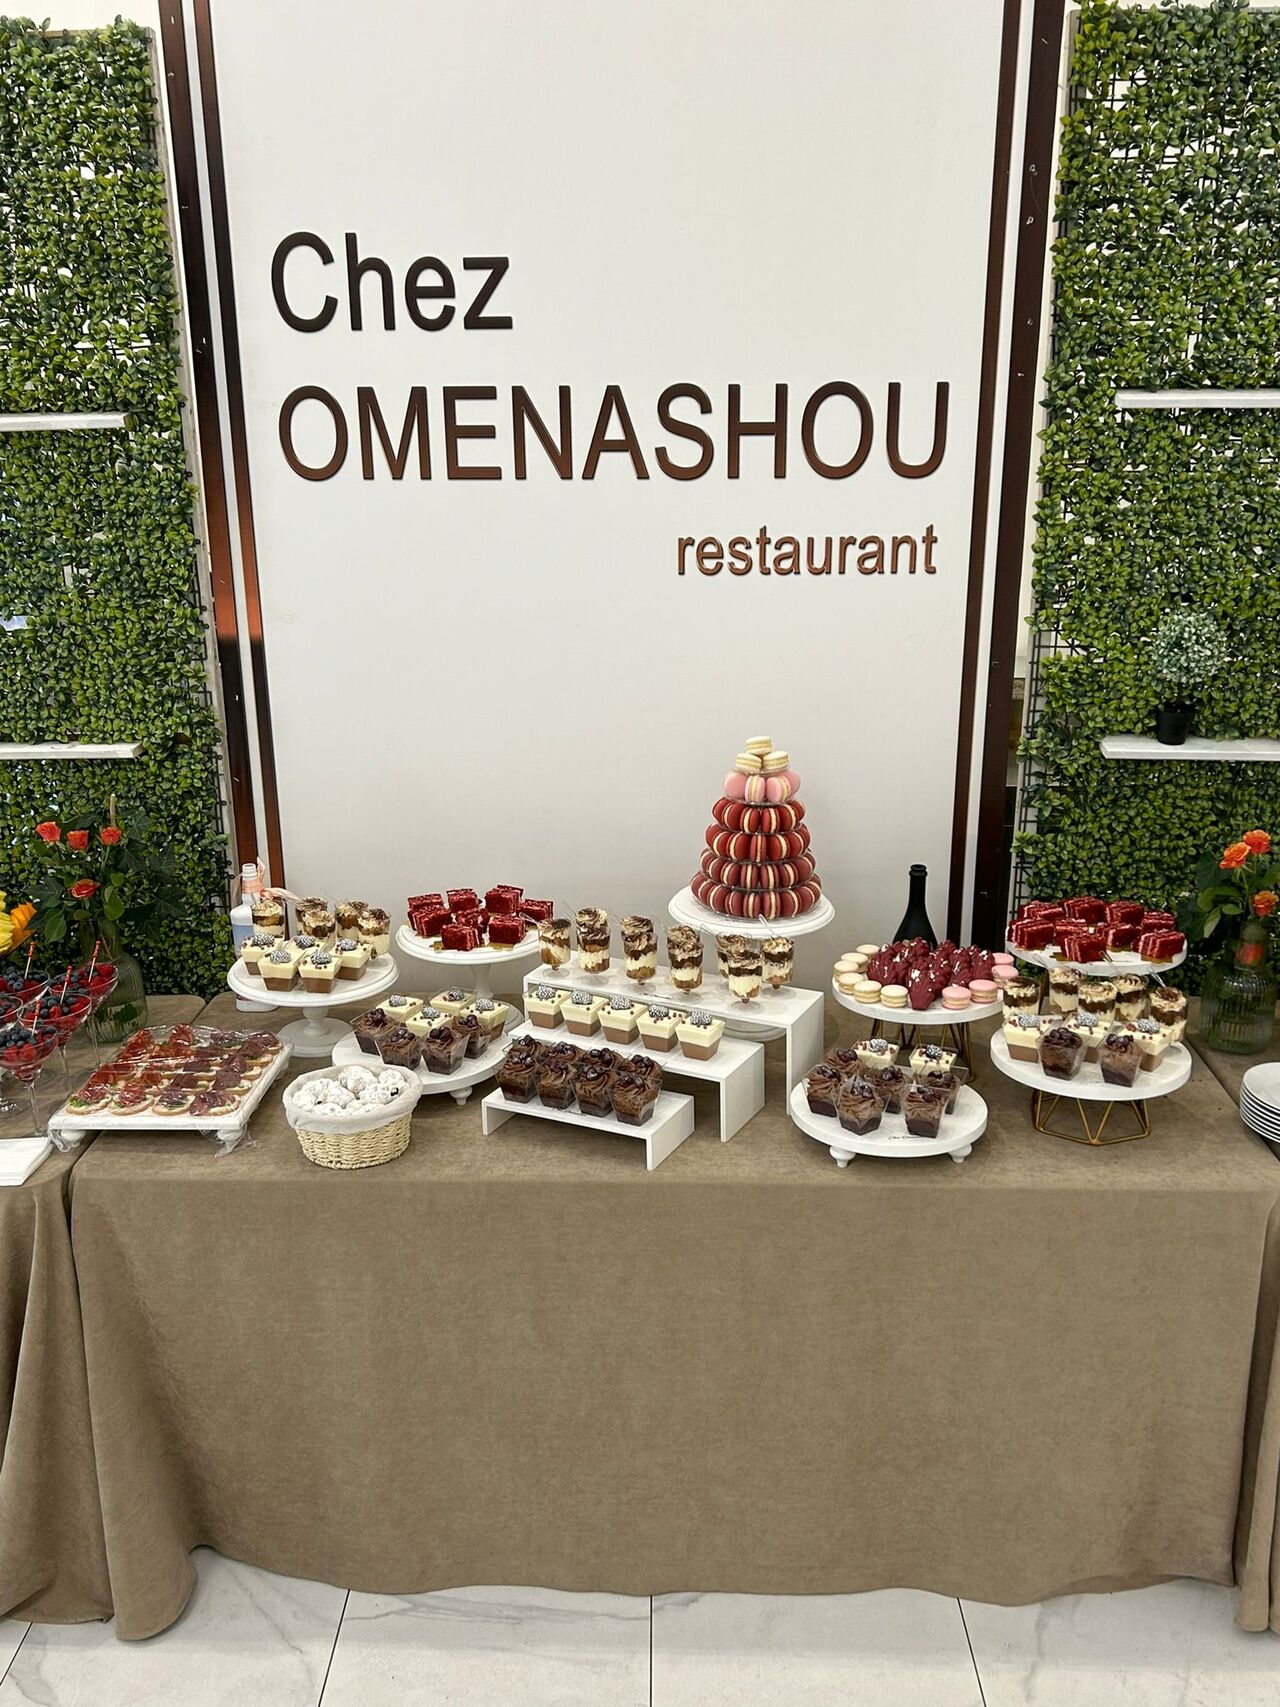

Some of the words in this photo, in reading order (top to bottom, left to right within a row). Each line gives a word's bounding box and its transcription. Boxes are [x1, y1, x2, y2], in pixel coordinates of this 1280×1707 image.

[271, 232, 513, 333] Chez
[279, 381, 950, 482] OMENASHOU
[677, 524, 938, 576] restaurant
